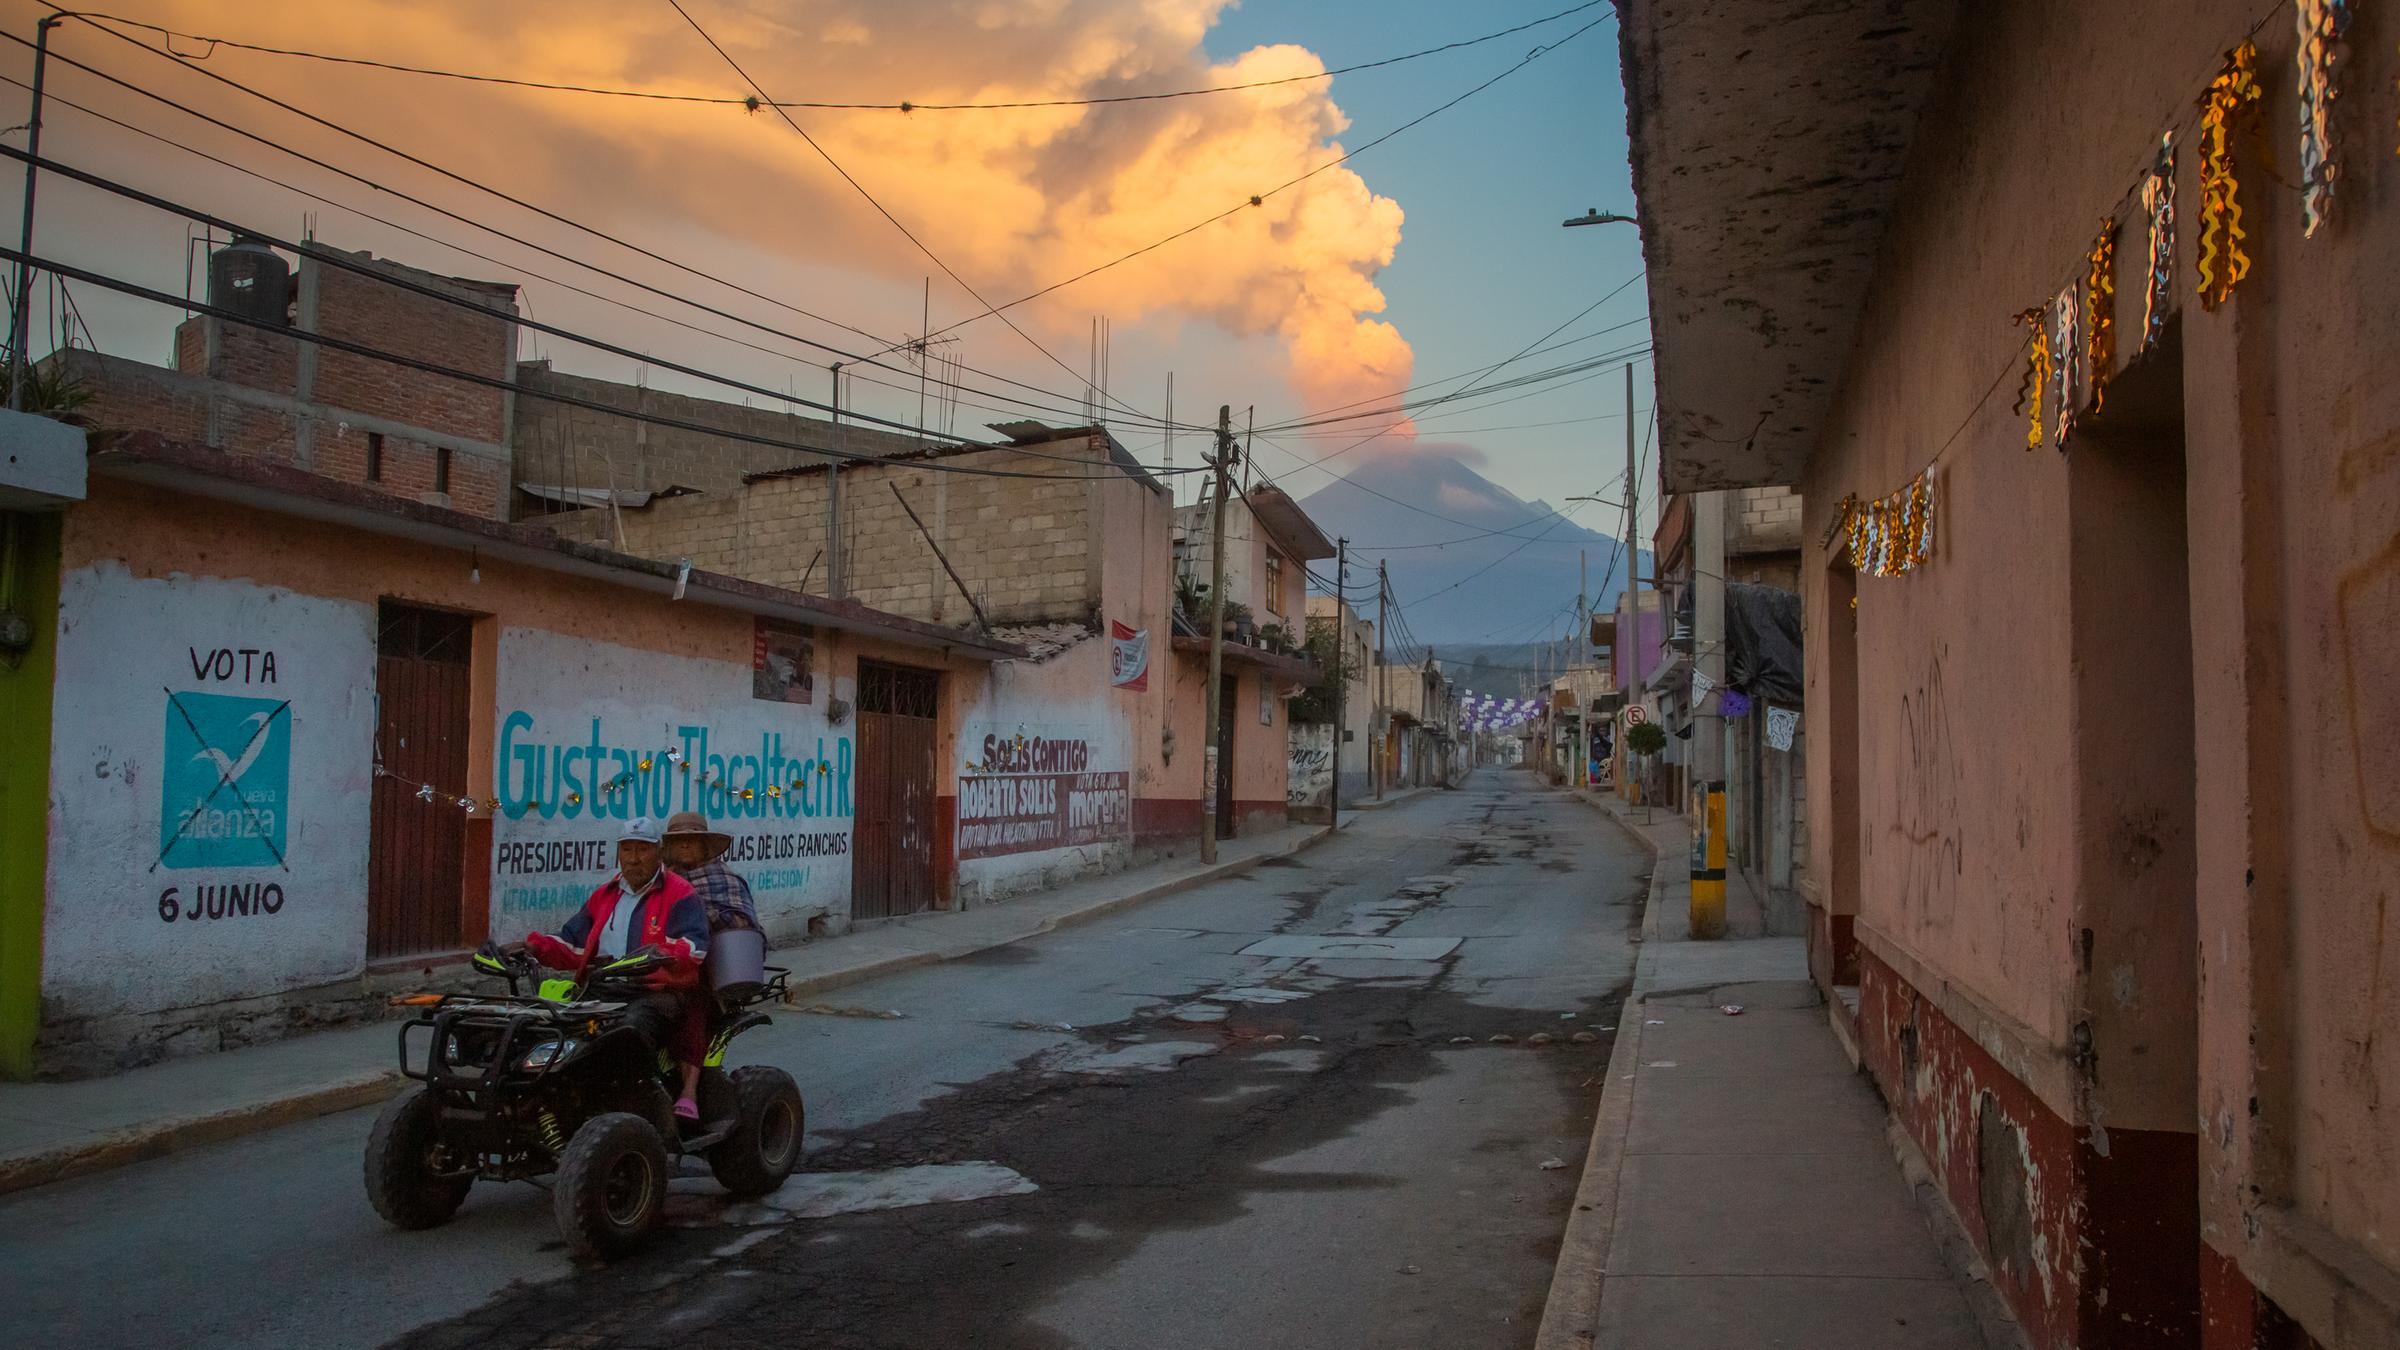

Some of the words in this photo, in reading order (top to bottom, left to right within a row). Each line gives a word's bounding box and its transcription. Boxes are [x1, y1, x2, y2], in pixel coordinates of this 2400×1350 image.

[190, 646, 277, 684] VOTA
[499, 710, 673, 820] Gustavo
[678, 725, 832, 820] Tlacaltech
[1032, 735, 1088, 772] CONTIGO
[234, 788, 277, 803] nueva
[960, 778, 1016, 820] ROBERTO
[1018, 778, 1057, 816] SOLIS
[1068, 788, 1128, 829] morena
[177, 797, 276, 839] alianza
[497, 840, 607, 875] PRESIDENTE
[757, 834, 773, 861] DE
[774, 833, 795, 859] LOS
[797, 831, 848, 859] RANCHOS
[158, 885, 180, 924] 6
[187, 882, 285, 921] JUNIO
